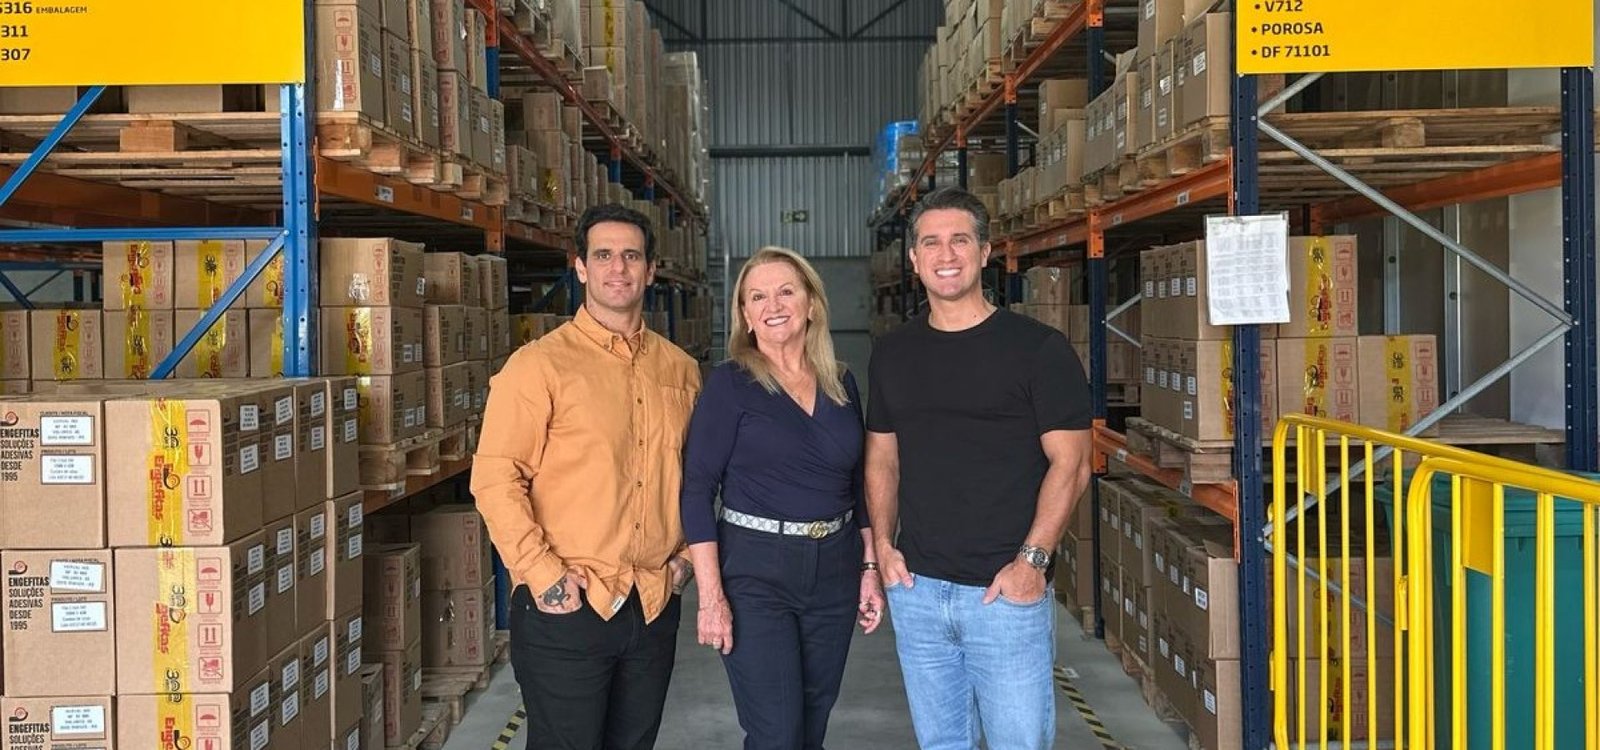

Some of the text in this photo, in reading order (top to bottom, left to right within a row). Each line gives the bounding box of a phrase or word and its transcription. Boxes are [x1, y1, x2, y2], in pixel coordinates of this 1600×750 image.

[0, 2, 88, 14] 316 EMBALAGEM
[1264, 0, 1304, 12] V712
[1261, 22, 1324, 36] POROSA
[1261, 45, 1331, 58] DF 71101
[0, 428, 40, 439] ENGEFITAS
[0, 438, 34, 450] SOLUÇÕES
[0, 450, 33, 460] ADESIVAS
[0, 461, 22, 471] DESDE
[1, 472, 18, 482] 1995
[9, 576, 50, 587] ENGEFITAS
[9, 587, 45, 598] SOLUÇÕES
[9, 599, 43, 609] ADESIVAS
[9, 610, 33, 620] DESDE
[10, 621, 28, 631] 1995
[9, 723, 50, 734] ENGEFITAS
[9, 733, 45, 745] SOLUÇÕES
